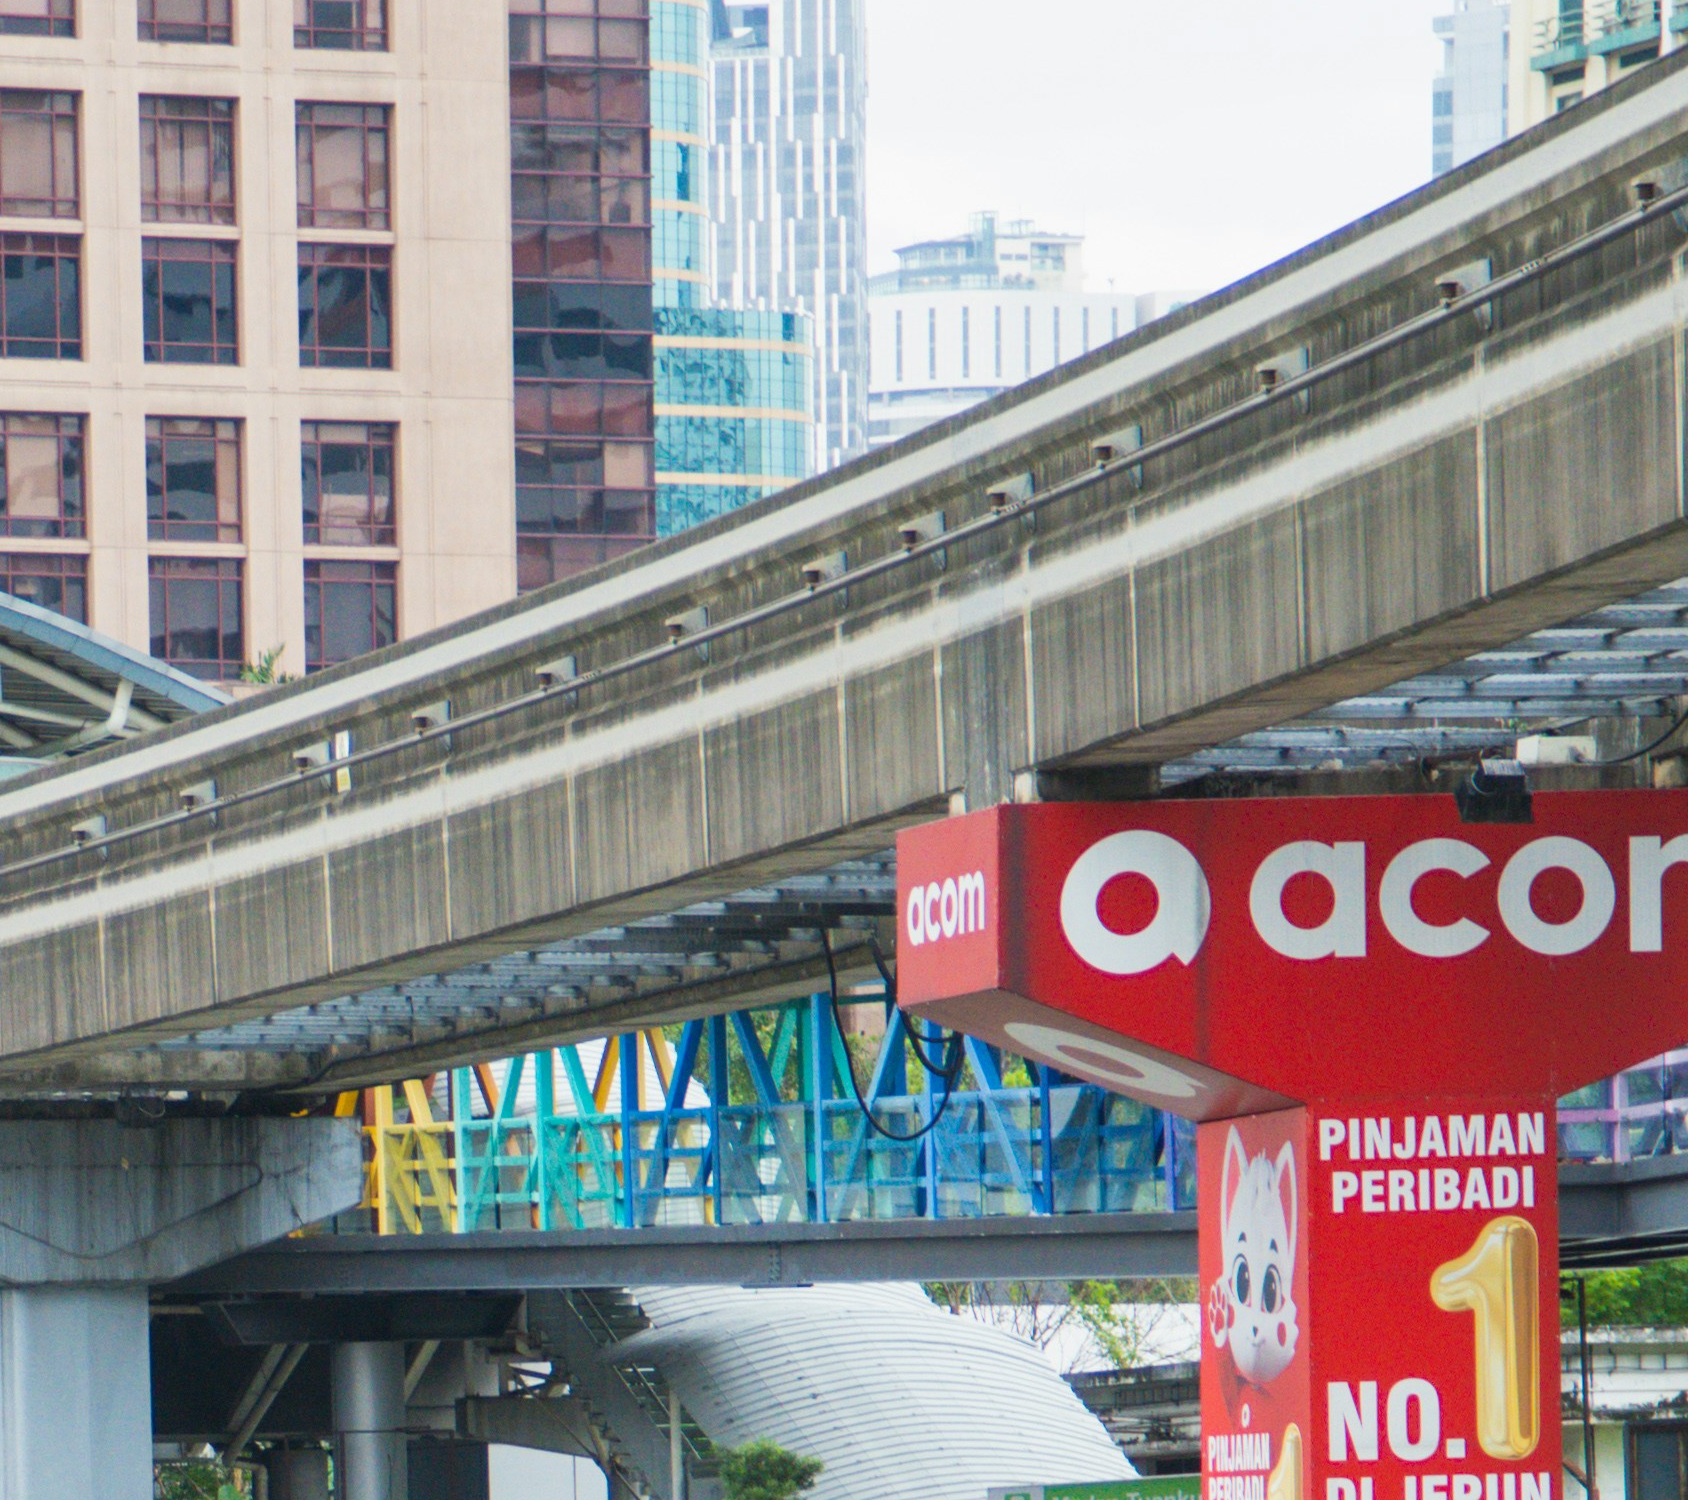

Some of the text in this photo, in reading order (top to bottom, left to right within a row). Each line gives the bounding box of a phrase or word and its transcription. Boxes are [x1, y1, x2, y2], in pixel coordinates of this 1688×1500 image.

[906, 869, 986, 947] acom
[1318, 1112, 1546, 1161] PINJAMAN
[1331, 1165, 1536, 1214] PERIBADI
[1326, 1377, 1467, 1463] NO.
[1208, 1432, 1271, 1473] PINJAMAN
